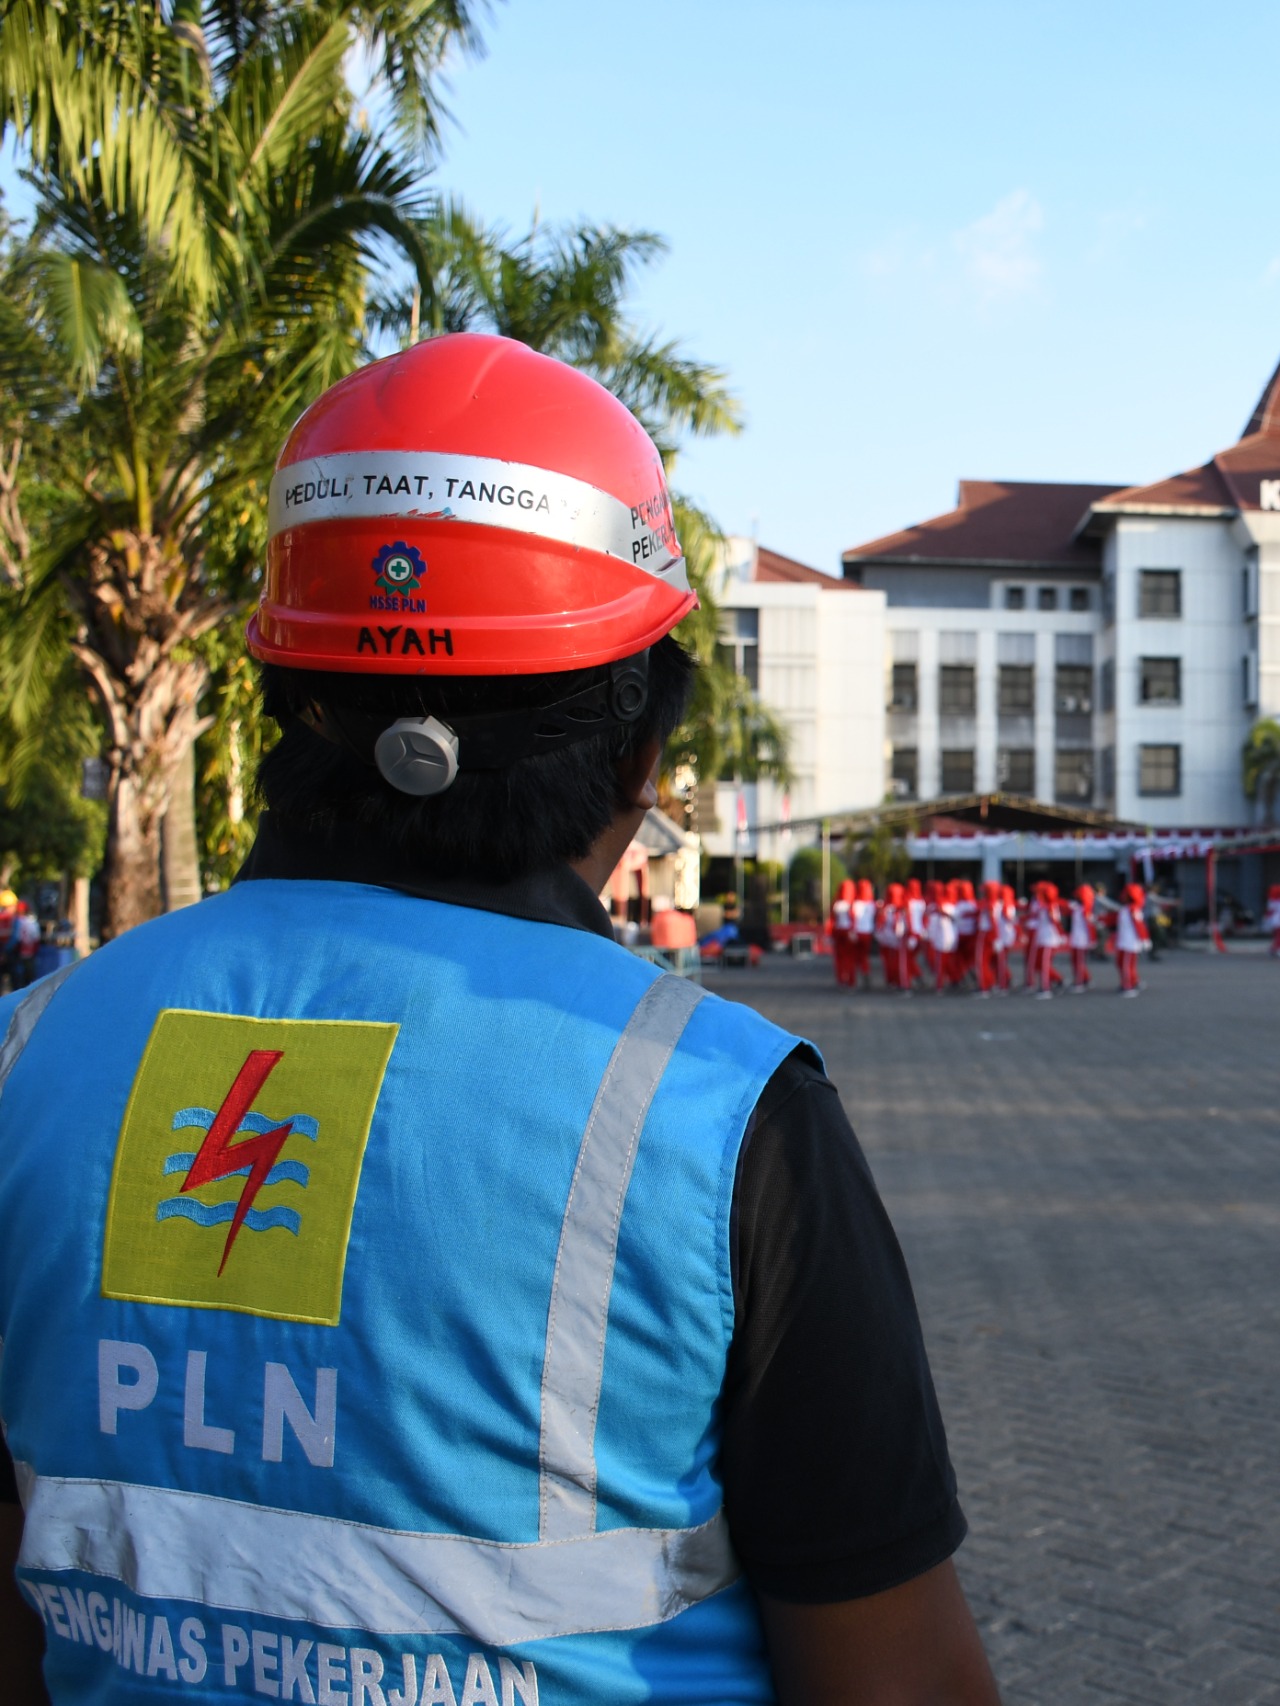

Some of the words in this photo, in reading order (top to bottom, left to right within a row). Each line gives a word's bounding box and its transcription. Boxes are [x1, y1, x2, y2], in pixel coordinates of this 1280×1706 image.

[363, 475, 433, 500] TAAT,
[369, 595, 399, 611] HSSE
[402, 597, 427, 613] PLN
[357, 625, 453, 656] AYAH
[98, 1338, 338, 1468] PLN
[20, 1578, 207, 1684] PENGAWAS
[221, 1624, 539, 1706] PEKERJAAN
